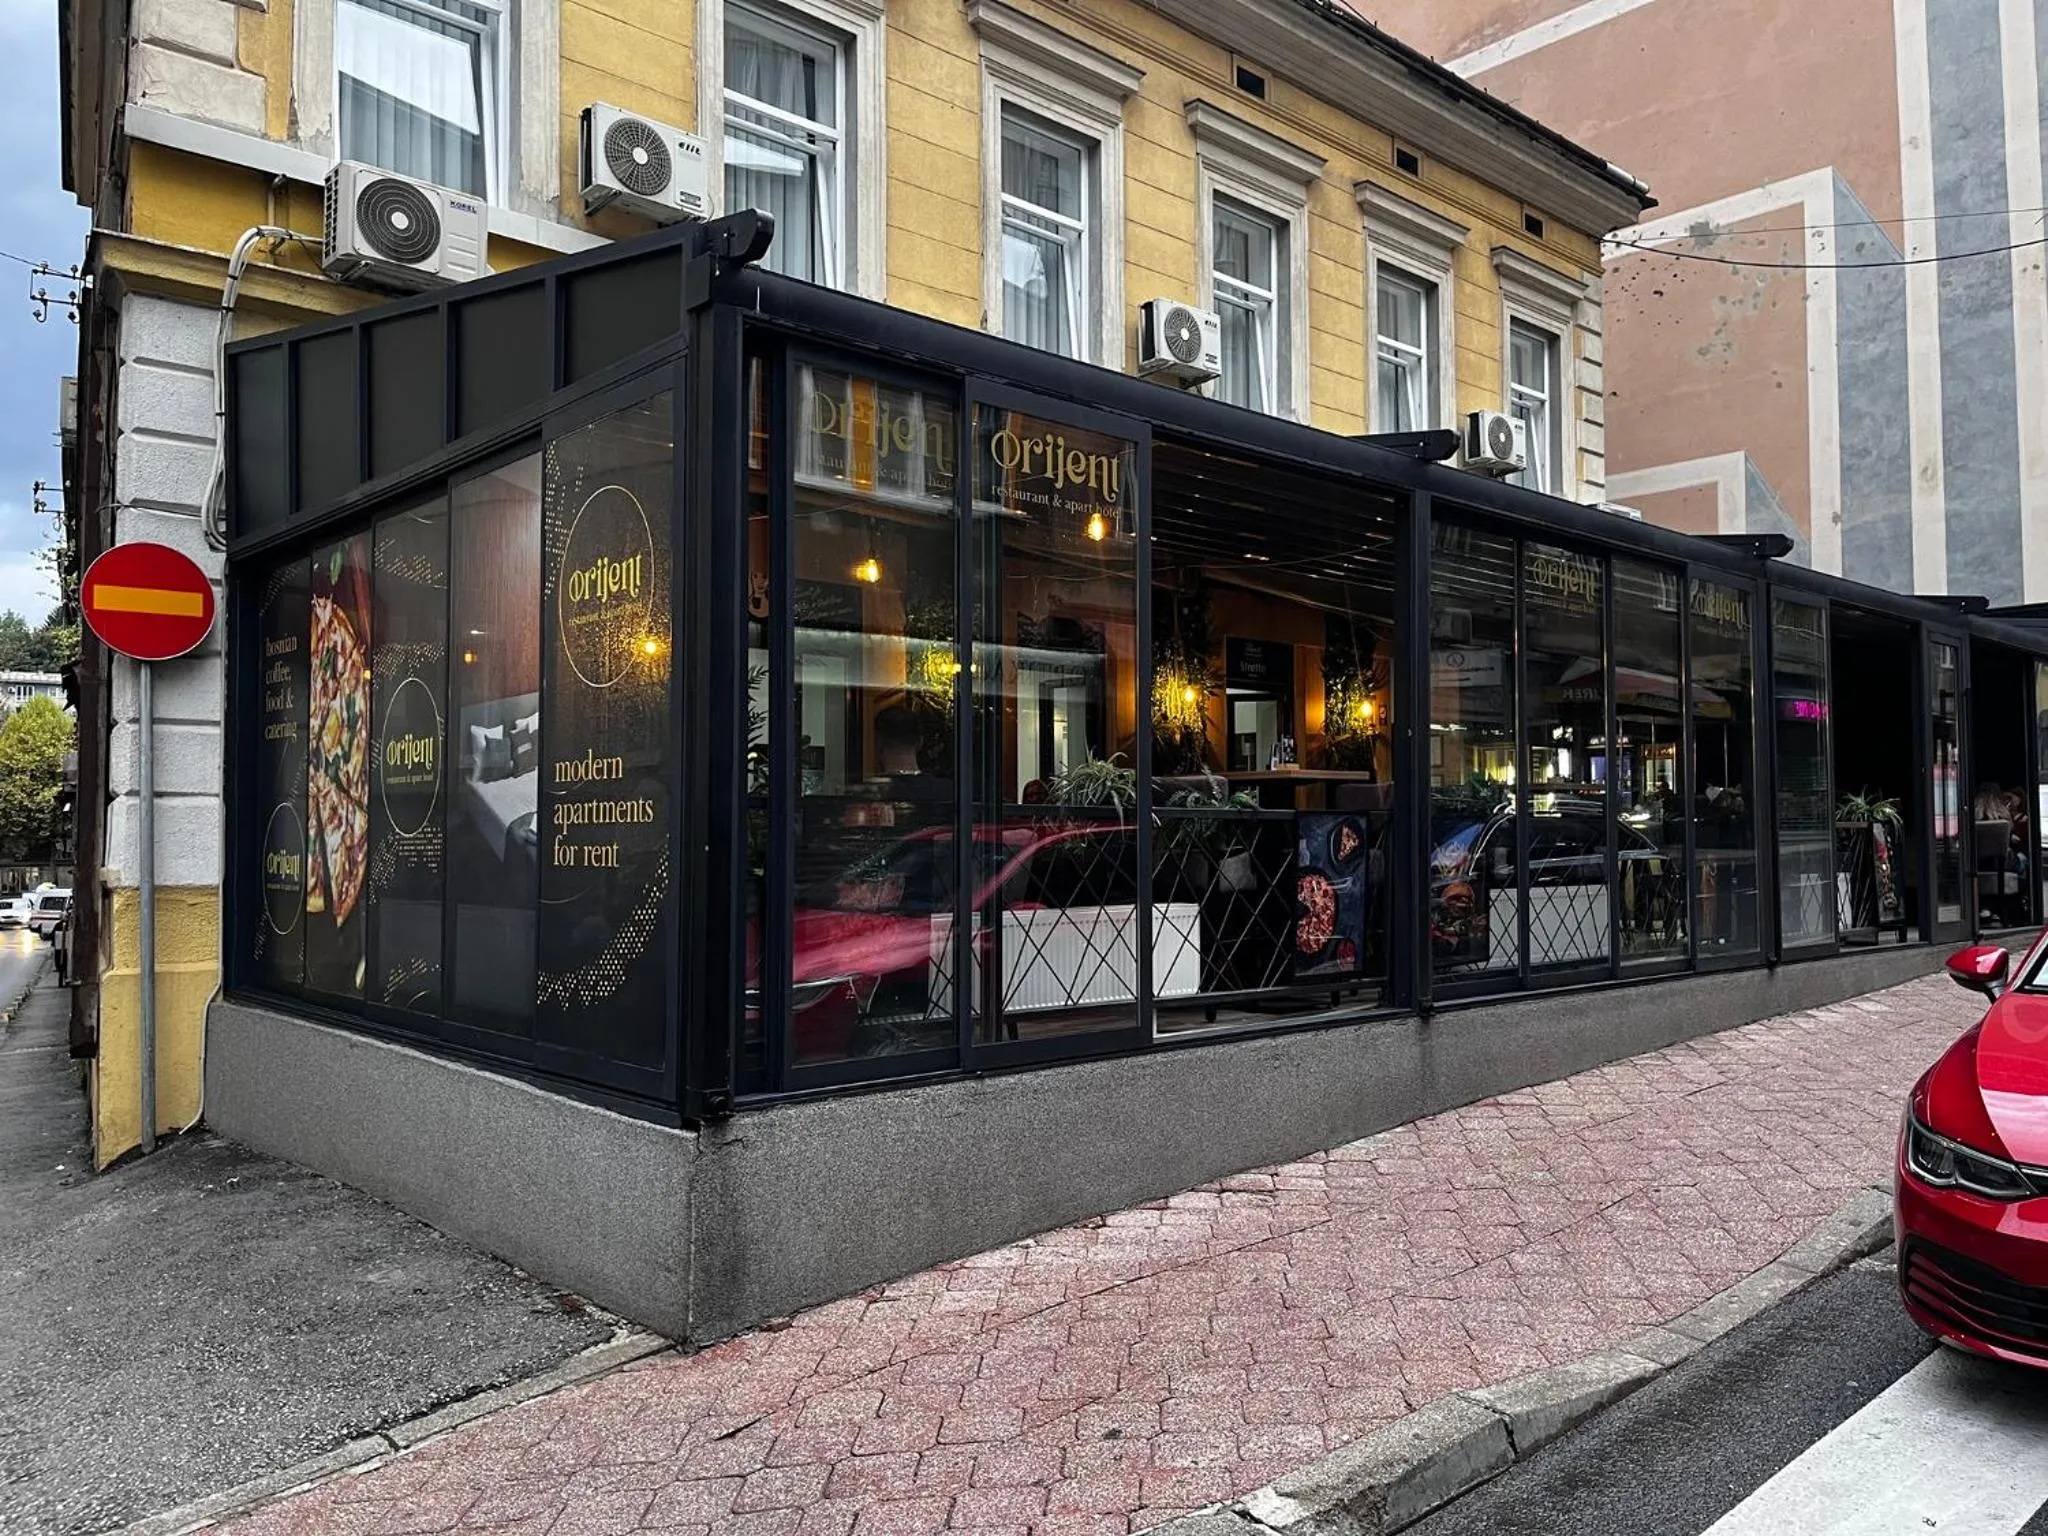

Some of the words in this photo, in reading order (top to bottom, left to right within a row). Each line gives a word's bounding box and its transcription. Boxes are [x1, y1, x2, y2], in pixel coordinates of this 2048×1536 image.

[992, 485, 1049, 506] restaurant
[1052, 494, 1062, 506] &
[1064, 500, 1093, 515] apart
[265, 688, 284, 712] food
[286, 687, 295, 709] &
[264, 716, 297, 743] catering
[555, 748, 623, 782] modern
[553, 797, 654, 835] apartments
[553, 834, 578, 866] for
[583, 843, 620, 868] rent
